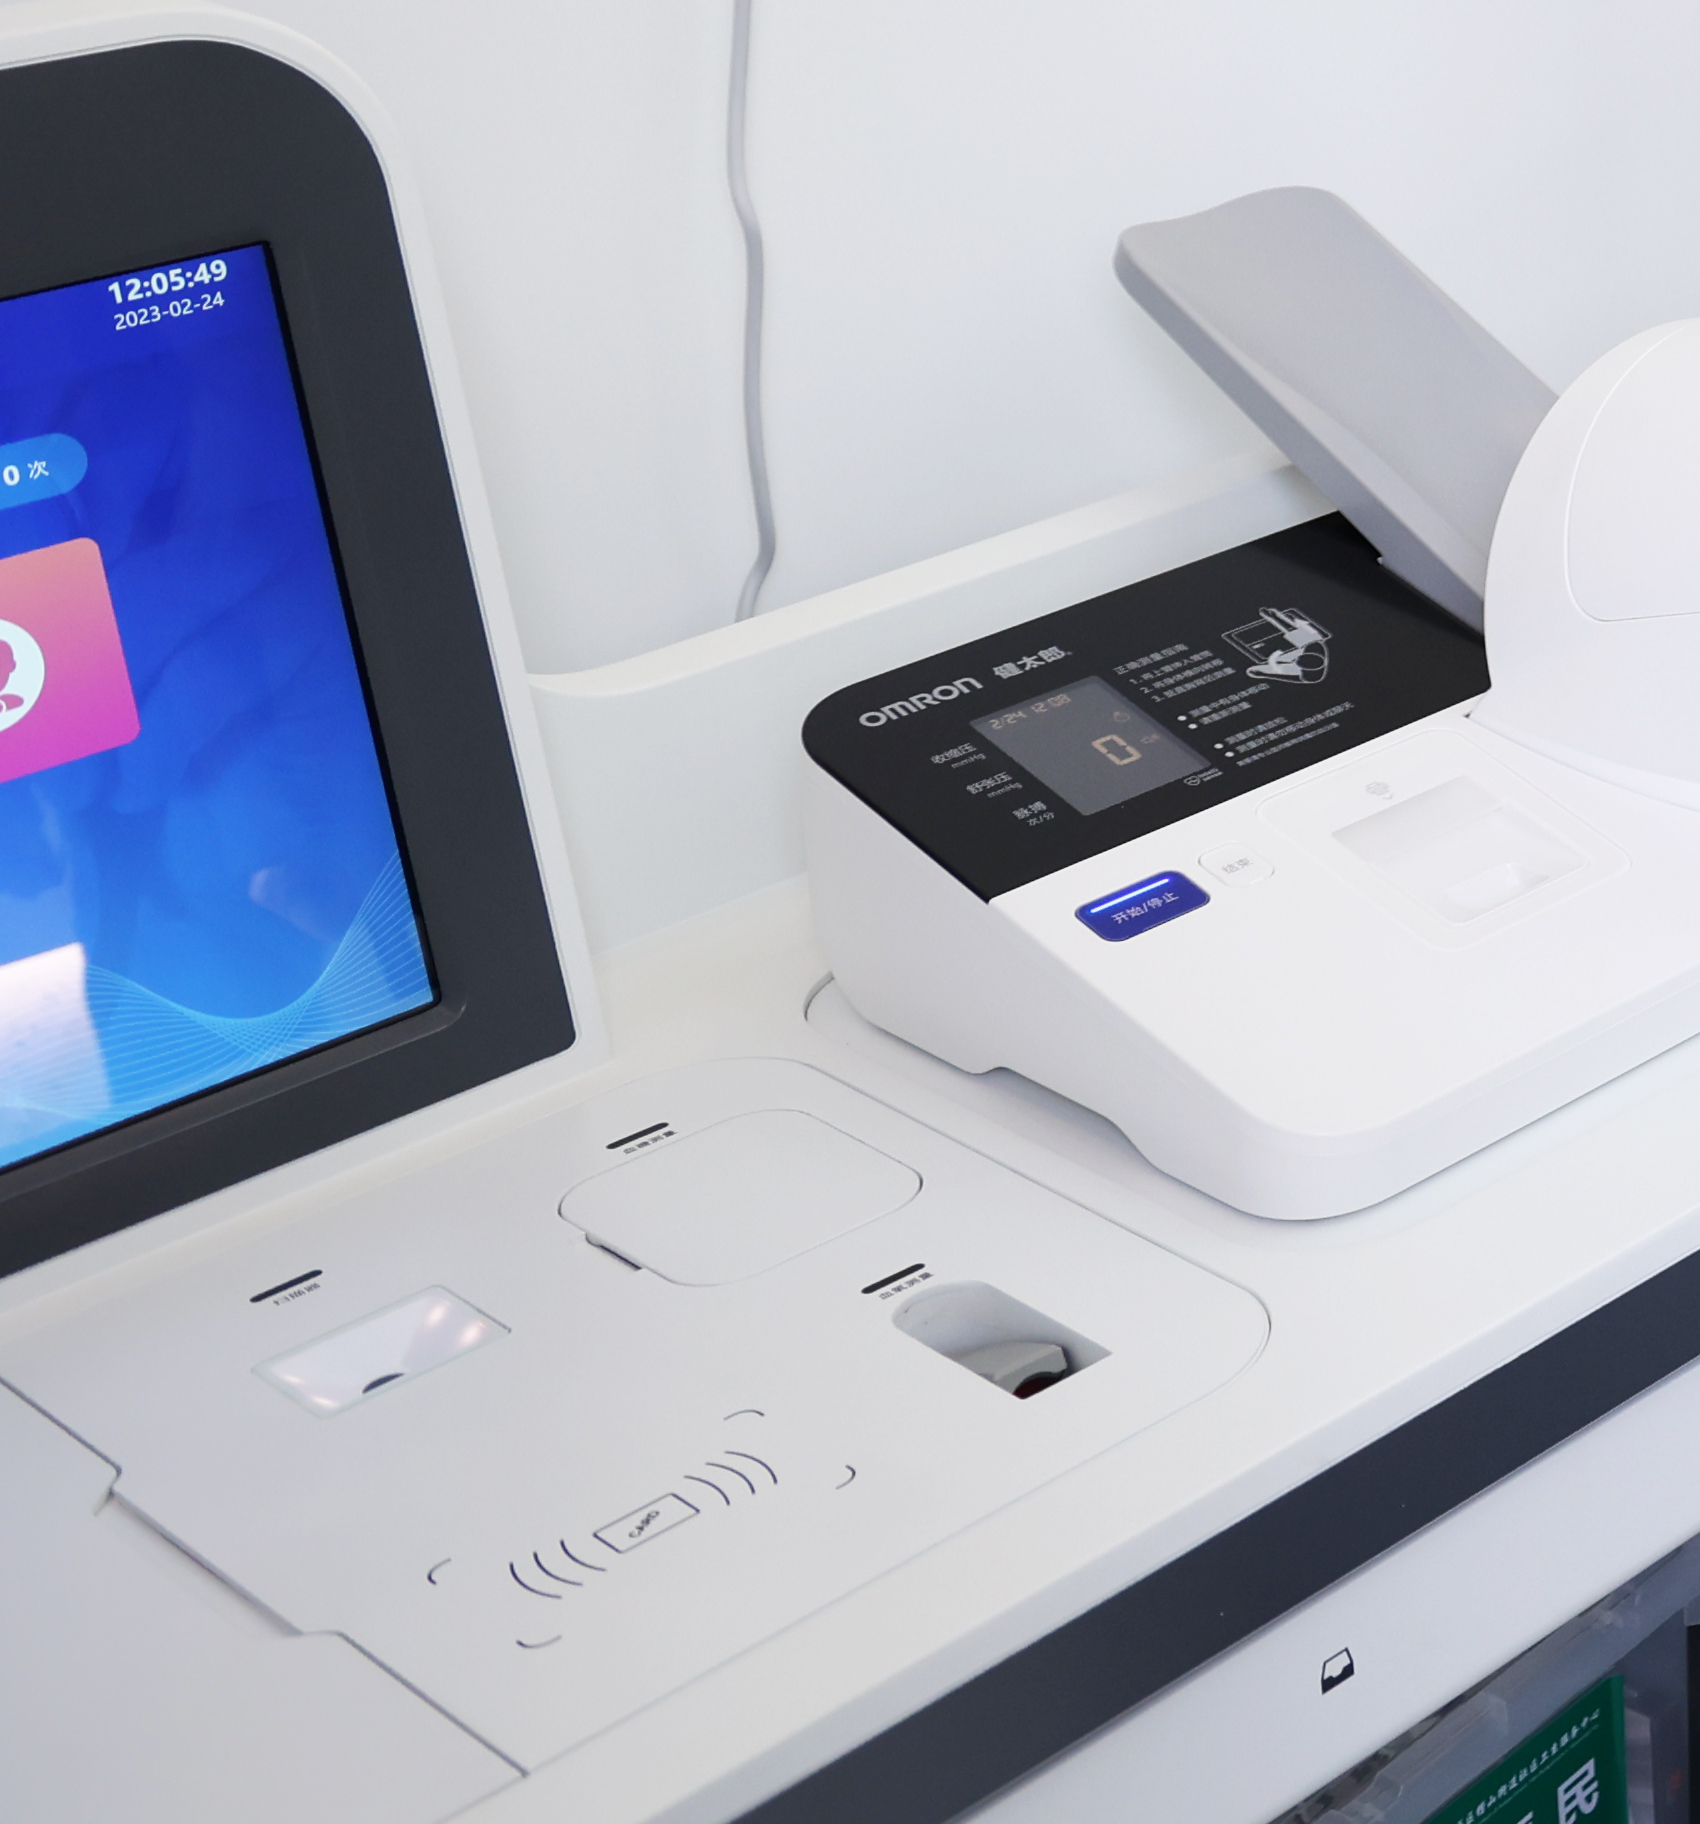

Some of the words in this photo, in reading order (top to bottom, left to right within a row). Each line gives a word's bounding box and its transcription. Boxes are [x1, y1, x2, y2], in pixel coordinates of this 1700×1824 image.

[107, 259, 228, 305] 12:05:49
[113, 291, 226, 331] 2023-02-24
[28, 459, 50, 481] 次
[858, 676, 984, 727] OMRON
[992, 645, 1067, 680] 健太郎
[1111, 891, 1180, 924] 开始/停止
